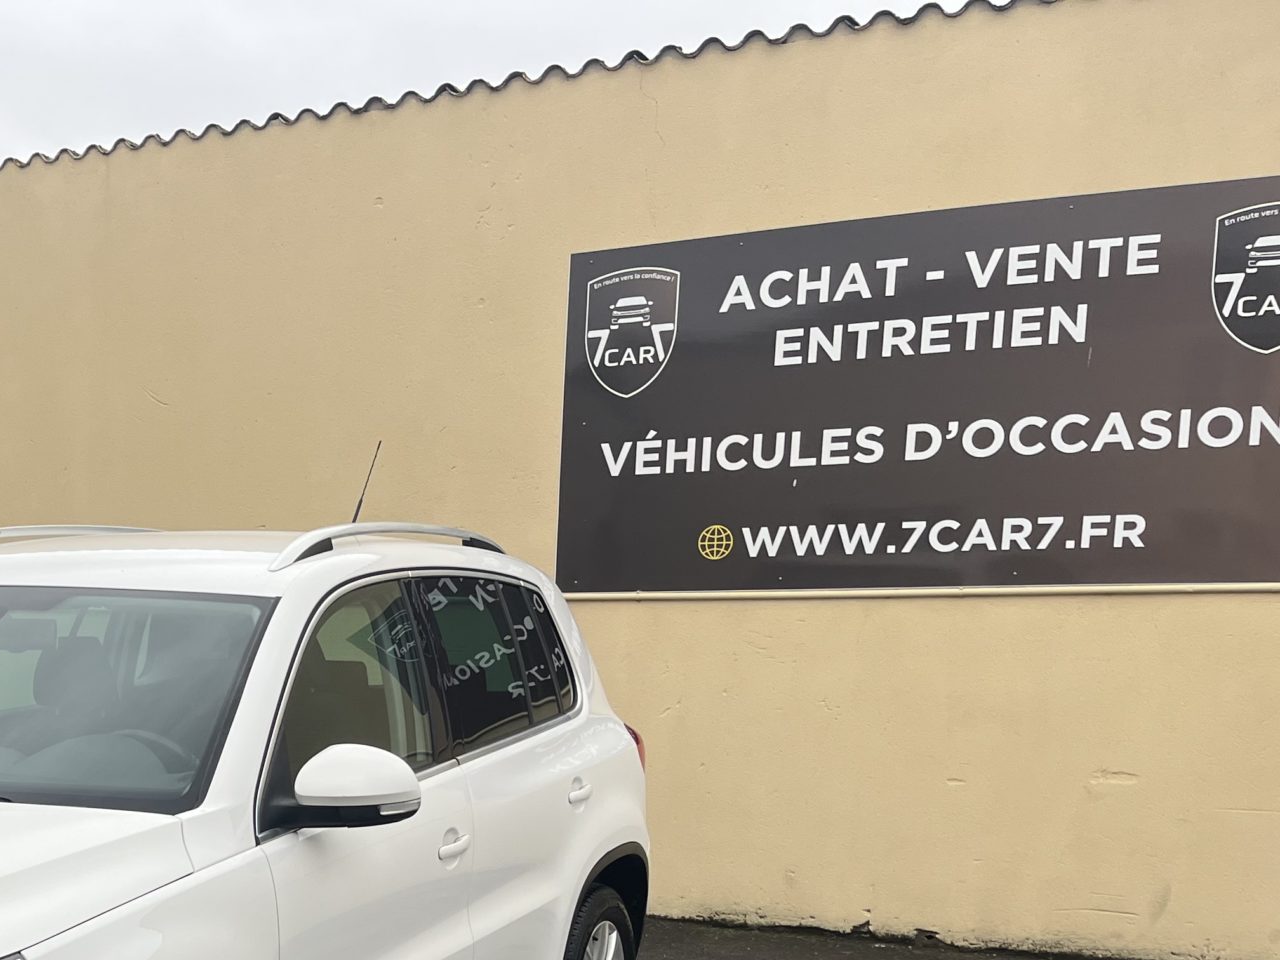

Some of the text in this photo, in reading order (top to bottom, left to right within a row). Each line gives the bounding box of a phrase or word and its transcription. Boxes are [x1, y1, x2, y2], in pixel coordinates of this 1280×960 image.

[1224, 208, 1279, 226] En route vers
[603, 277, 619, 286] route
[620, 273, 634, 281] vers
[641, 272, 670, 281] confiance
[719, 258, 908, 312] ACHAT
[965, 234, 1161, 288] VENTE
[774, 304, 1087, 366] ENTRETIEN
[601, 426, 884, 477] VÉHICULES
[742, 514, 1146, 558] WWW.7CAR7.FR
